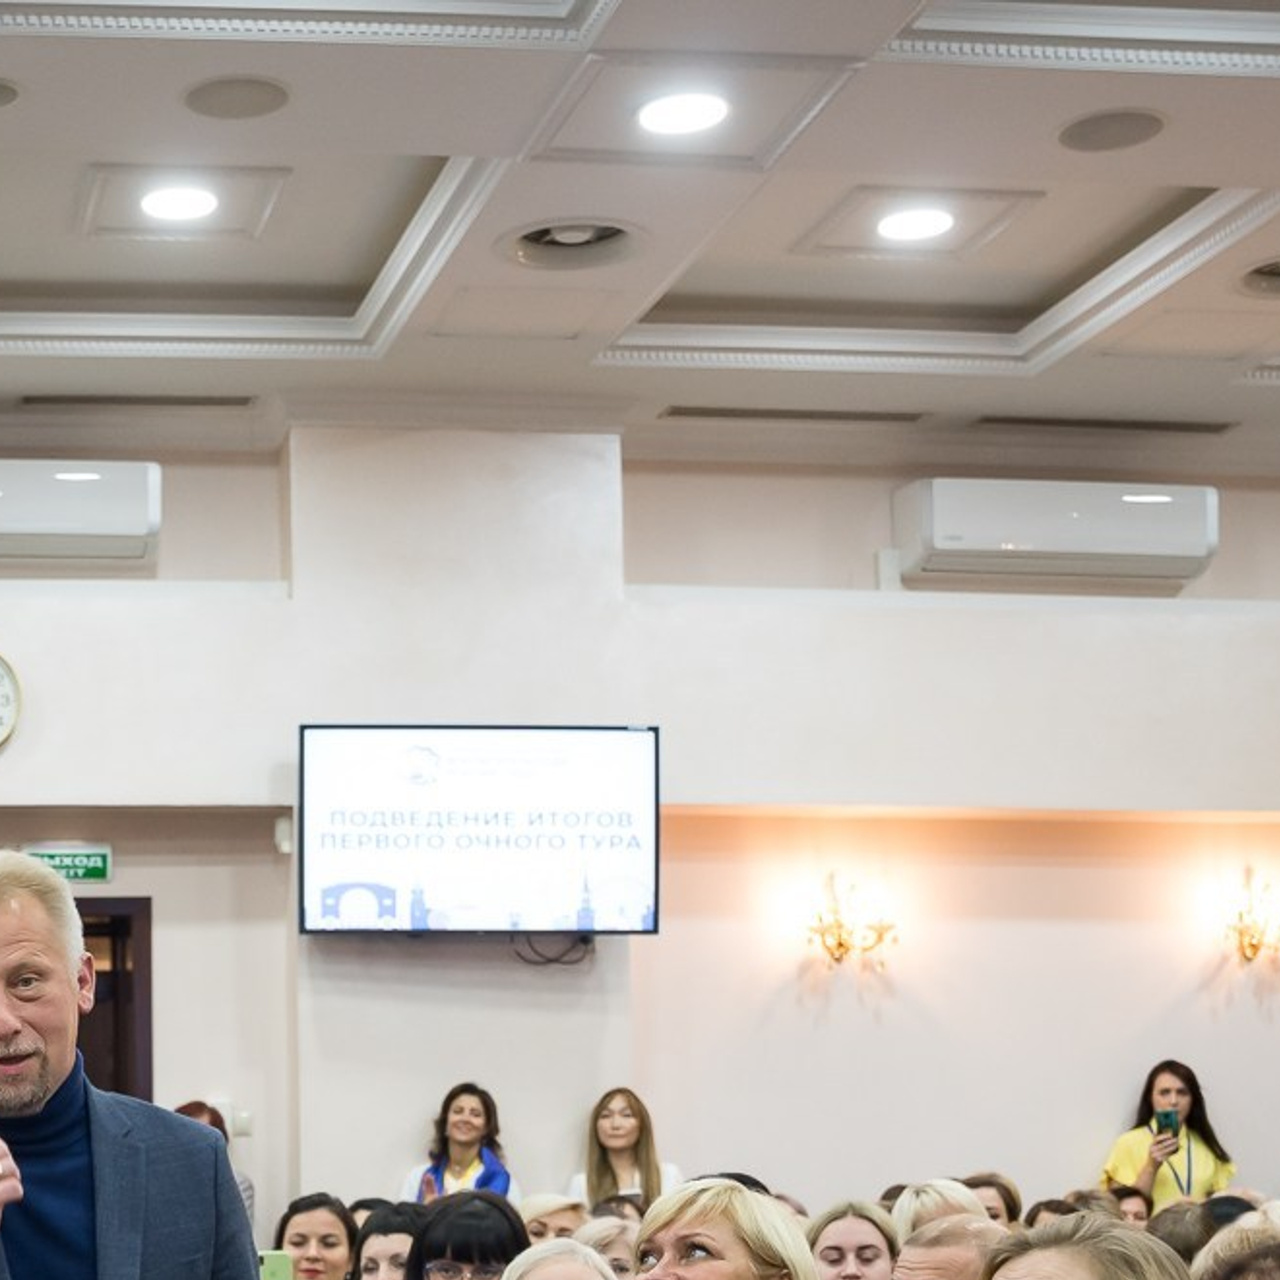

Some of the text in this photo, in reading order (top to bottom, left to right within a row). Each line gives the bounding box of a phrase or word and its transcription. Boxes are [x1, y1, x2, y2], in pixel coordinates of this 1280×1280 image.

[330, 811, 634, 829] ПОДВЕДЕНИЕ ИТОГОВ
[320, 832, 642, 850] ПЕРВОГО ОЧНОГО ТУРА
